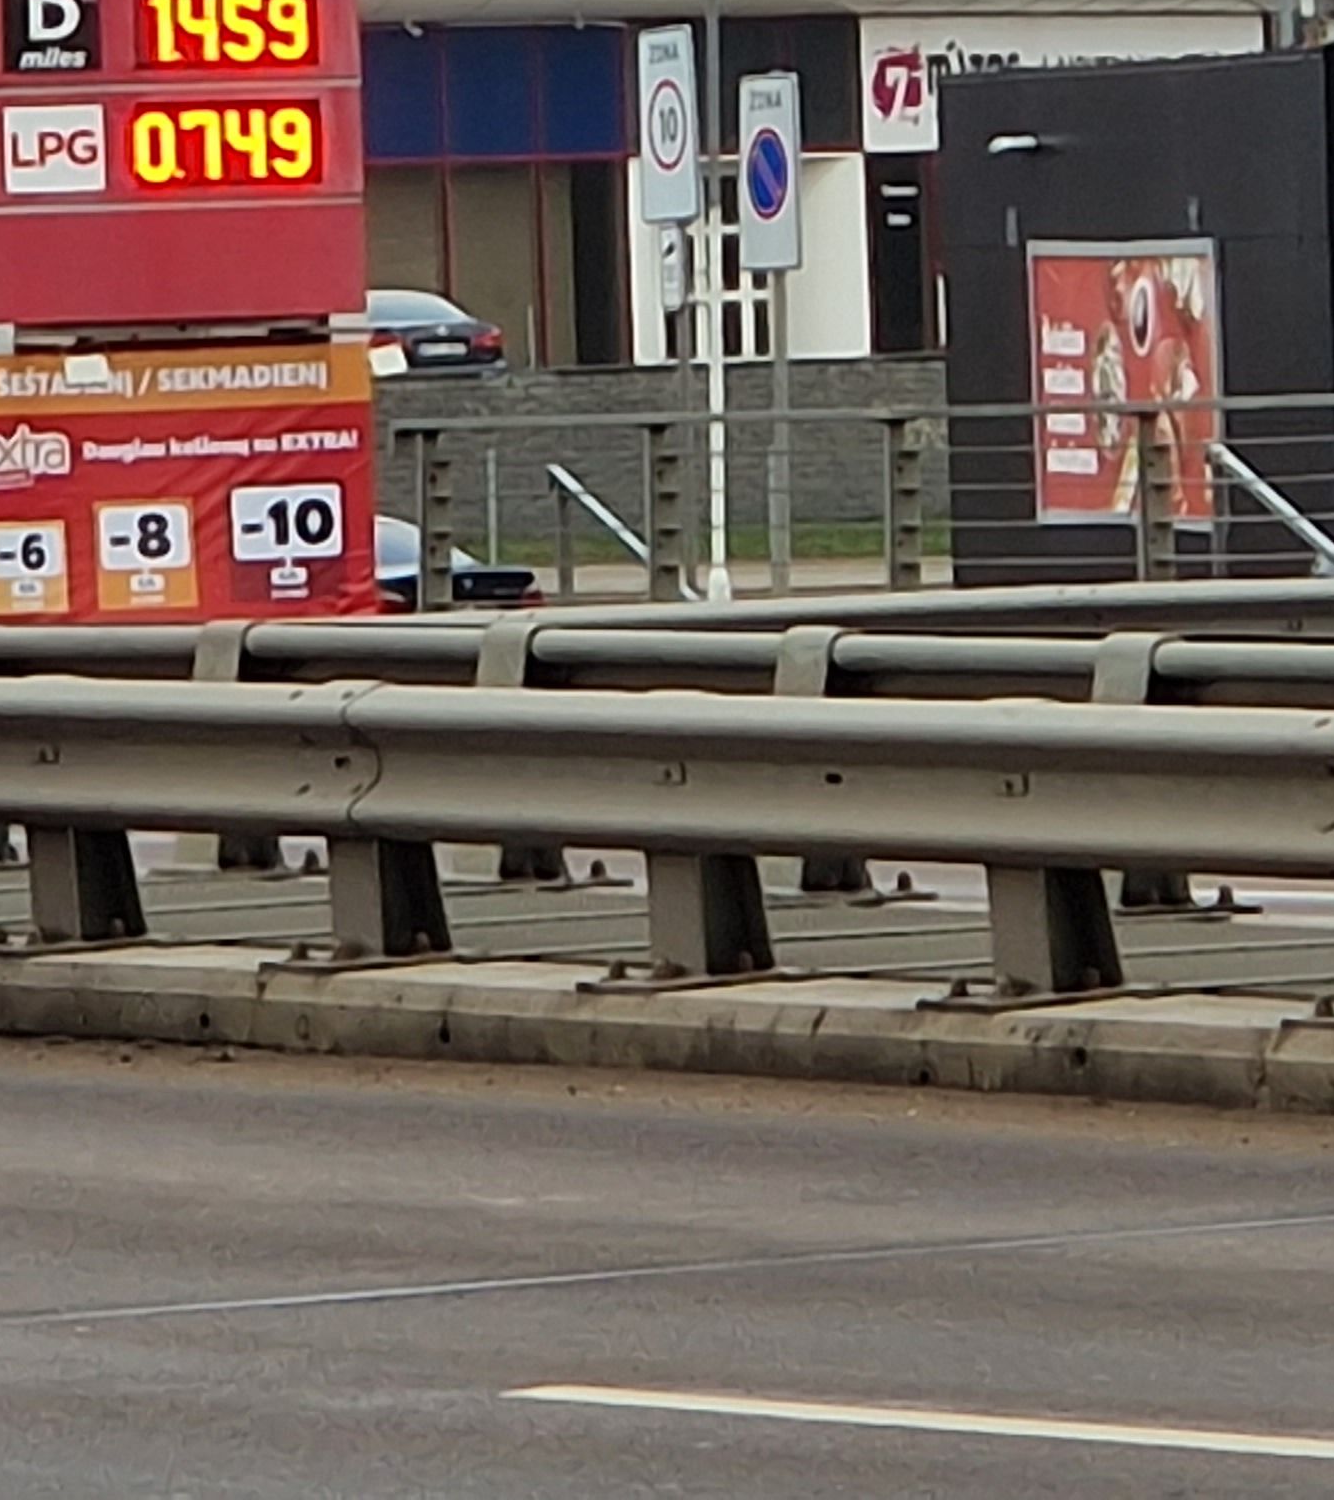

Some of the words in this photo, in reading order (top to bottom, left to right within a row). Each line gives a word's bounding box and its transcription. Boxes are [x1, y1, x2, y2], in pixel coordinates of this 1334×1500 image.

[18, 47, 87, 70] miles
[659, 106, 679, 145] 10
[10, 129, 99, 168] LPG
[109, 512, 172, 559] -8
[241, 498, 334, 545] -10
